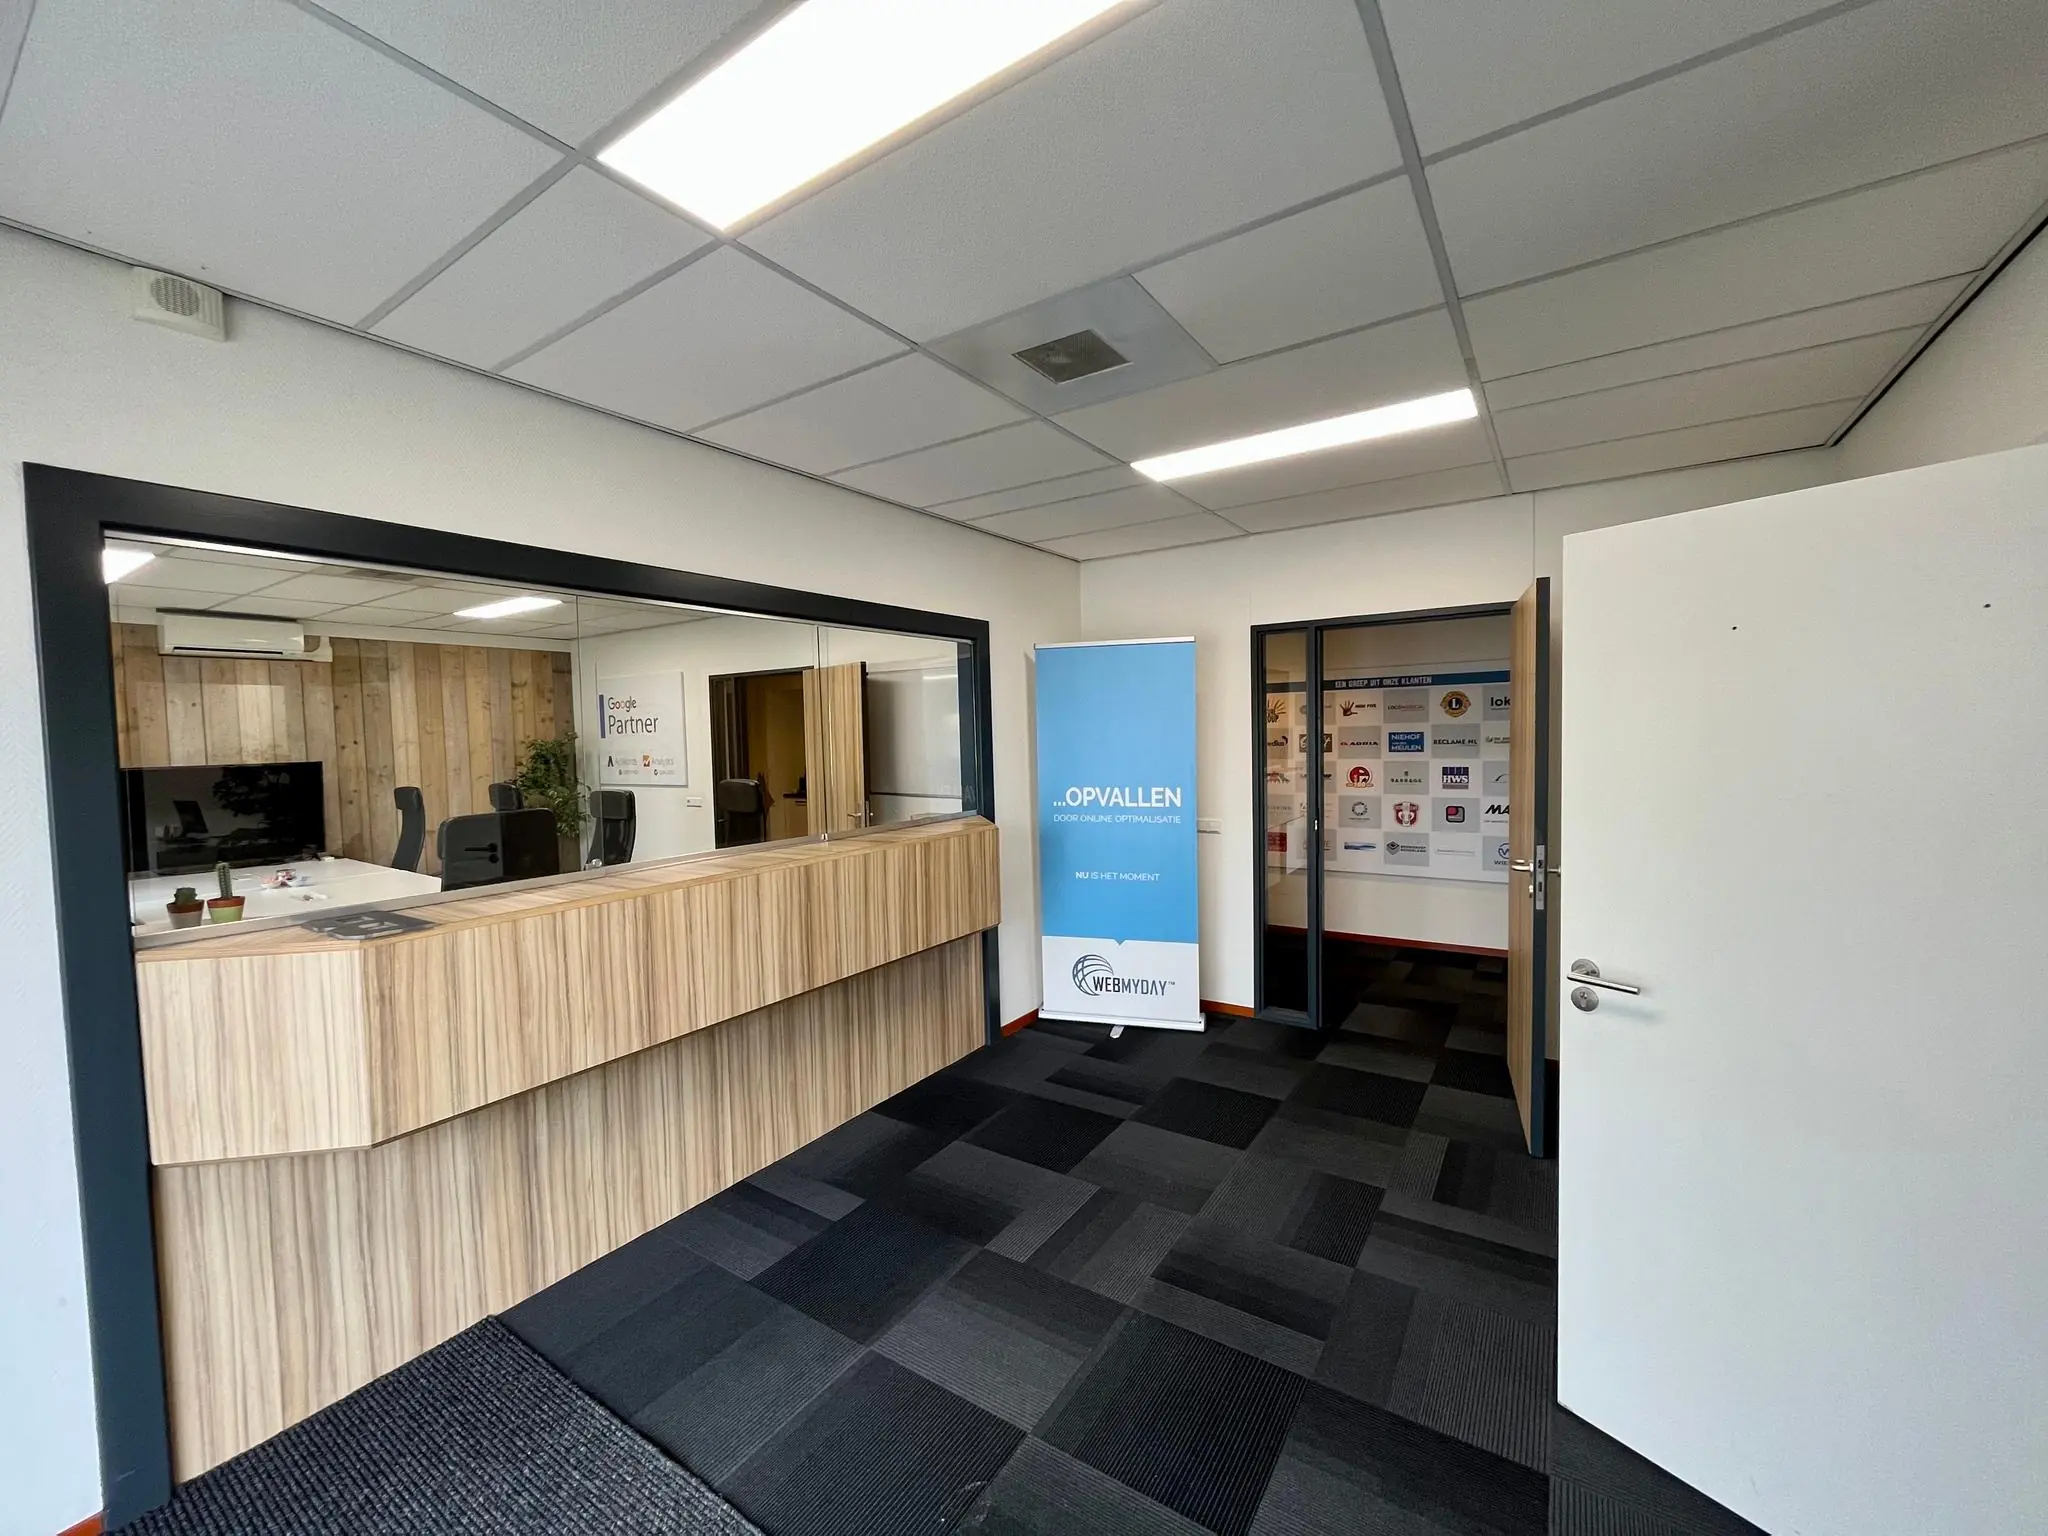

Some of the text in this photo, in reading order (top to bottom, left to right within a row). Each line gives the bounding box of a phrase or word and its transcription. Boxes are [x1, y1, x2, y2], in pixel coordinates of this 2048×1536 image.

[1370, 679, 1380, 687] UIT
[1401, 676, 1432, 685] KLANTEN
[607, 696, 637, 712] Google
[608, 715, 659, 735] Partner
[1443, 775, 1469, 784] HWS
[1053, 814, 1181, 824] DOOR ONLINE OPTIMALISATIE
[1075, 871, 1160, 881] NU IS HET MOMENT
[1092, 975, 1167, 996] WEBMYDAY
